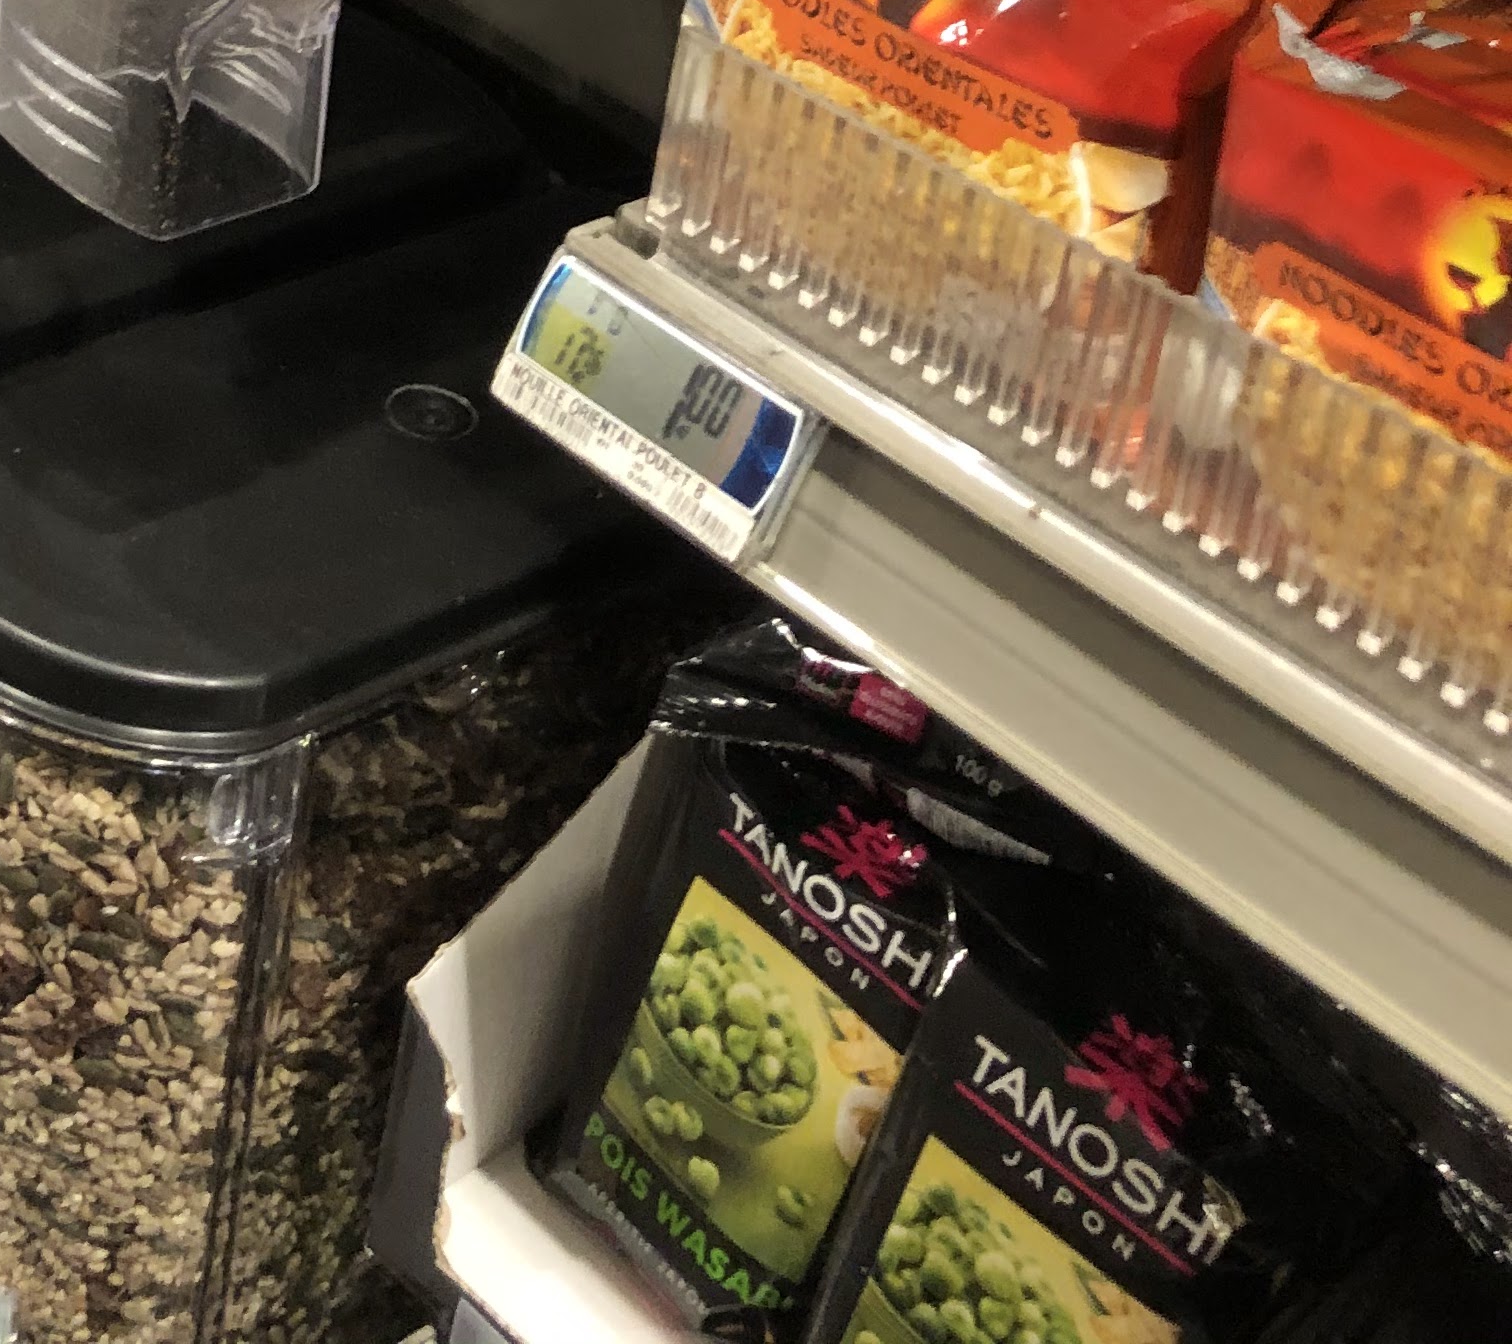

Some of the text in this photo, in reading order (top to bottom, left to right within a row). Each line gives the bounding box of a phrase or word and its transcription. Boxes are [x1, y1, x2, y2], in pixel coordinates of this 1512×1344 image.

[874, 31, 1053, 140] ORIENTALES
[760, 892, 870, 991] JAPON
[583, 1112, 653, 1201] POIS
[1001, 1150, 1136, 1262] JAPON
